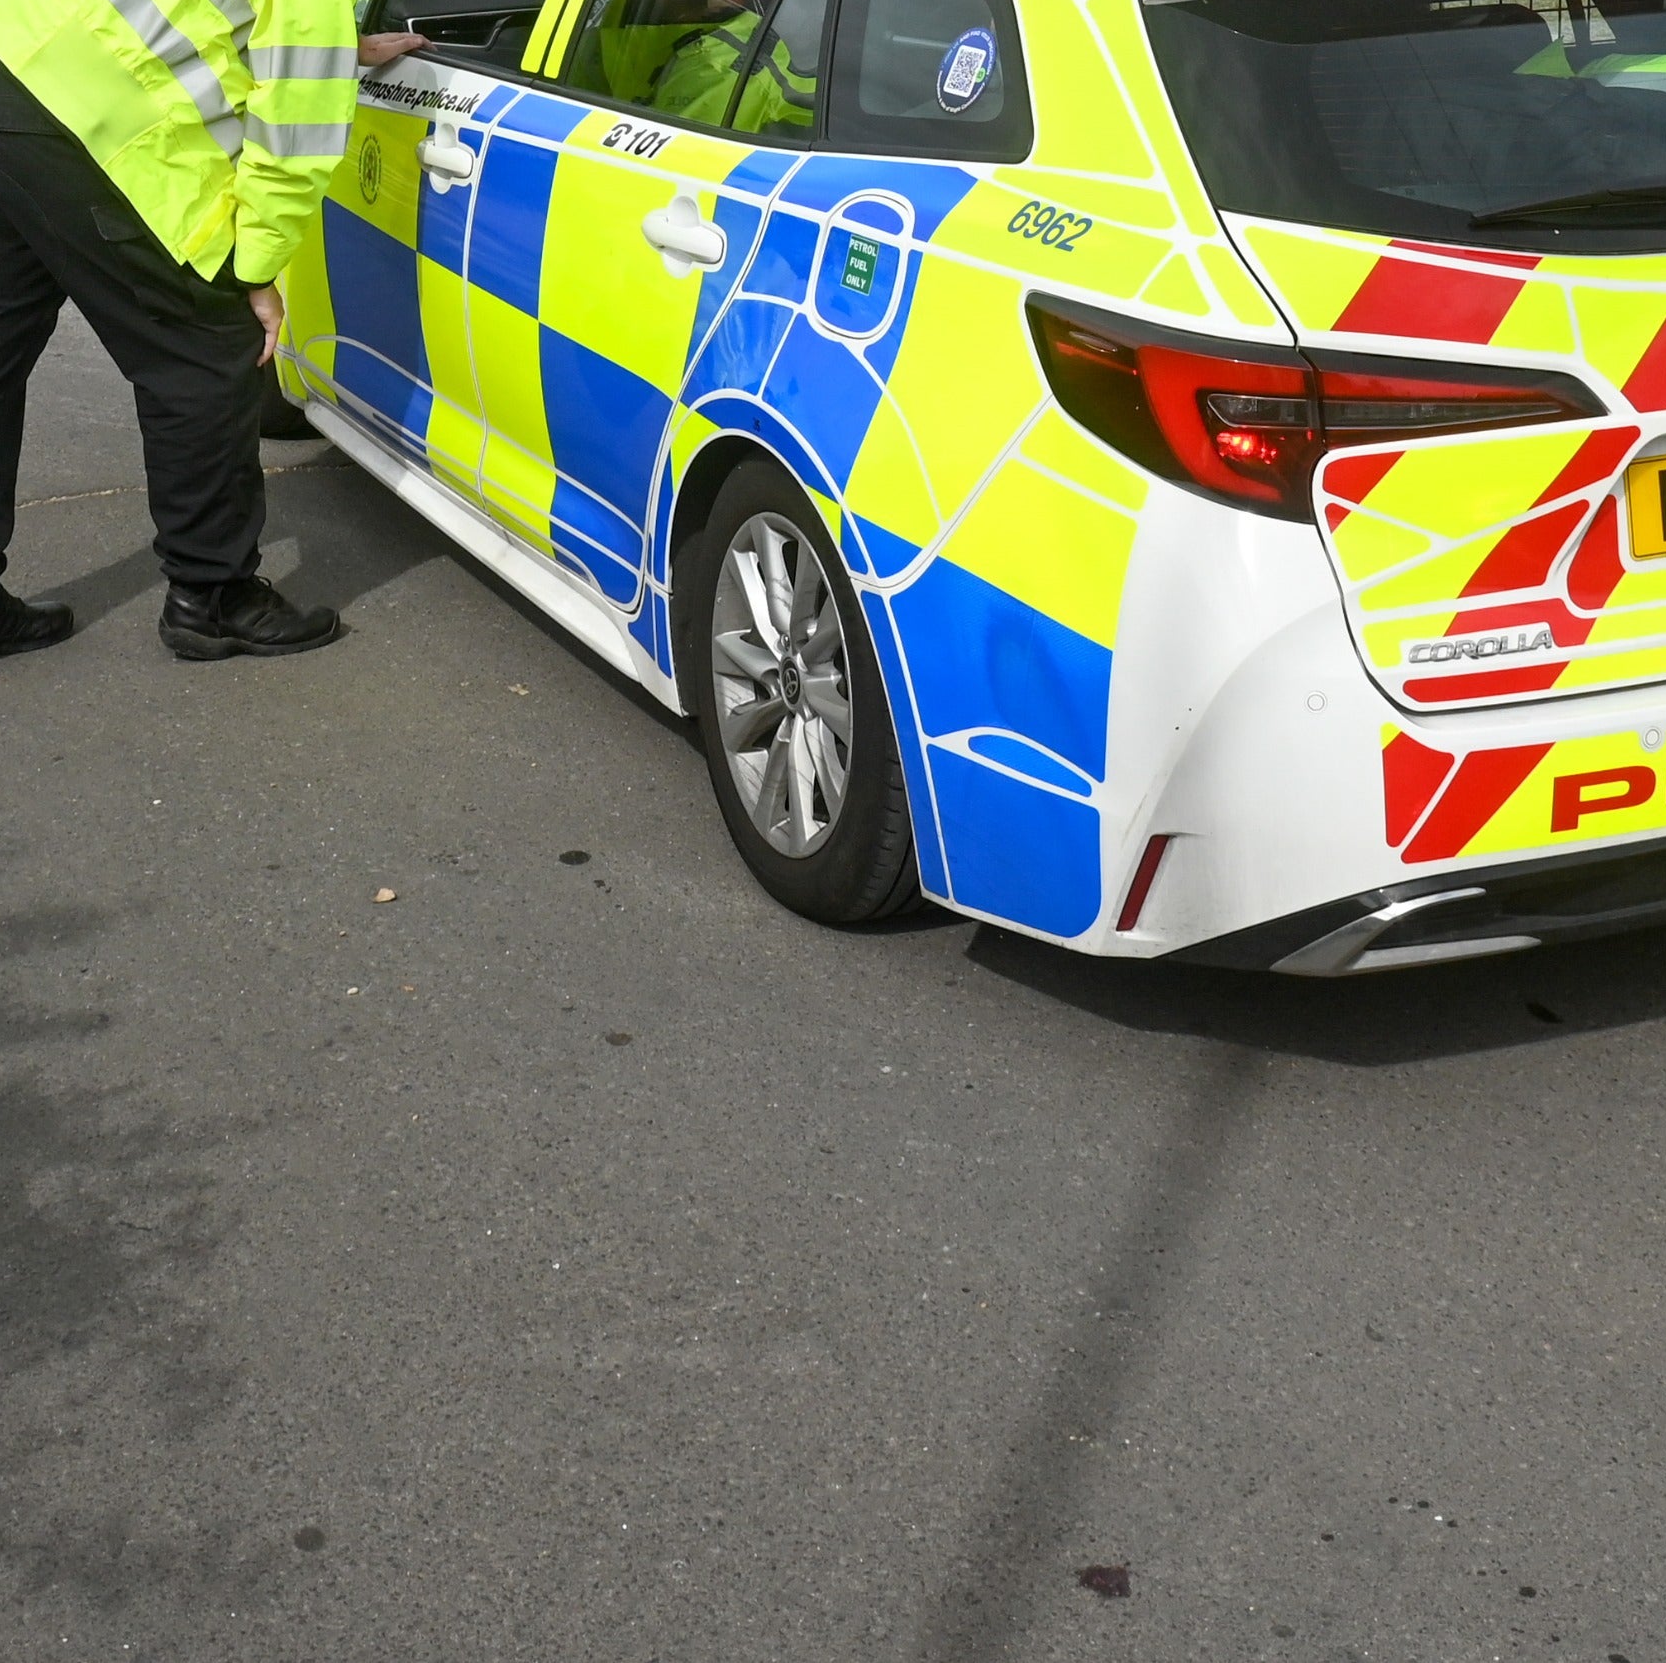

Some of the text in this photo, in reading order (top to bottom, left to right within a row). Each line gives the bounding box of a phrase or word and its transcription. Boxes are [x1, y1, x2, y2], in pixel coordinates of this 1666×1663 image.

[624, 129, 672, 159] 101
[1007, 200, 1093, 253] 6962
[849, 238, 877, 257] PETROL
[849, 256, 868, 273] FUEL
[845, 273, 867, 289] ONLY
[1408, 629, 1553, 664] COROLLA
